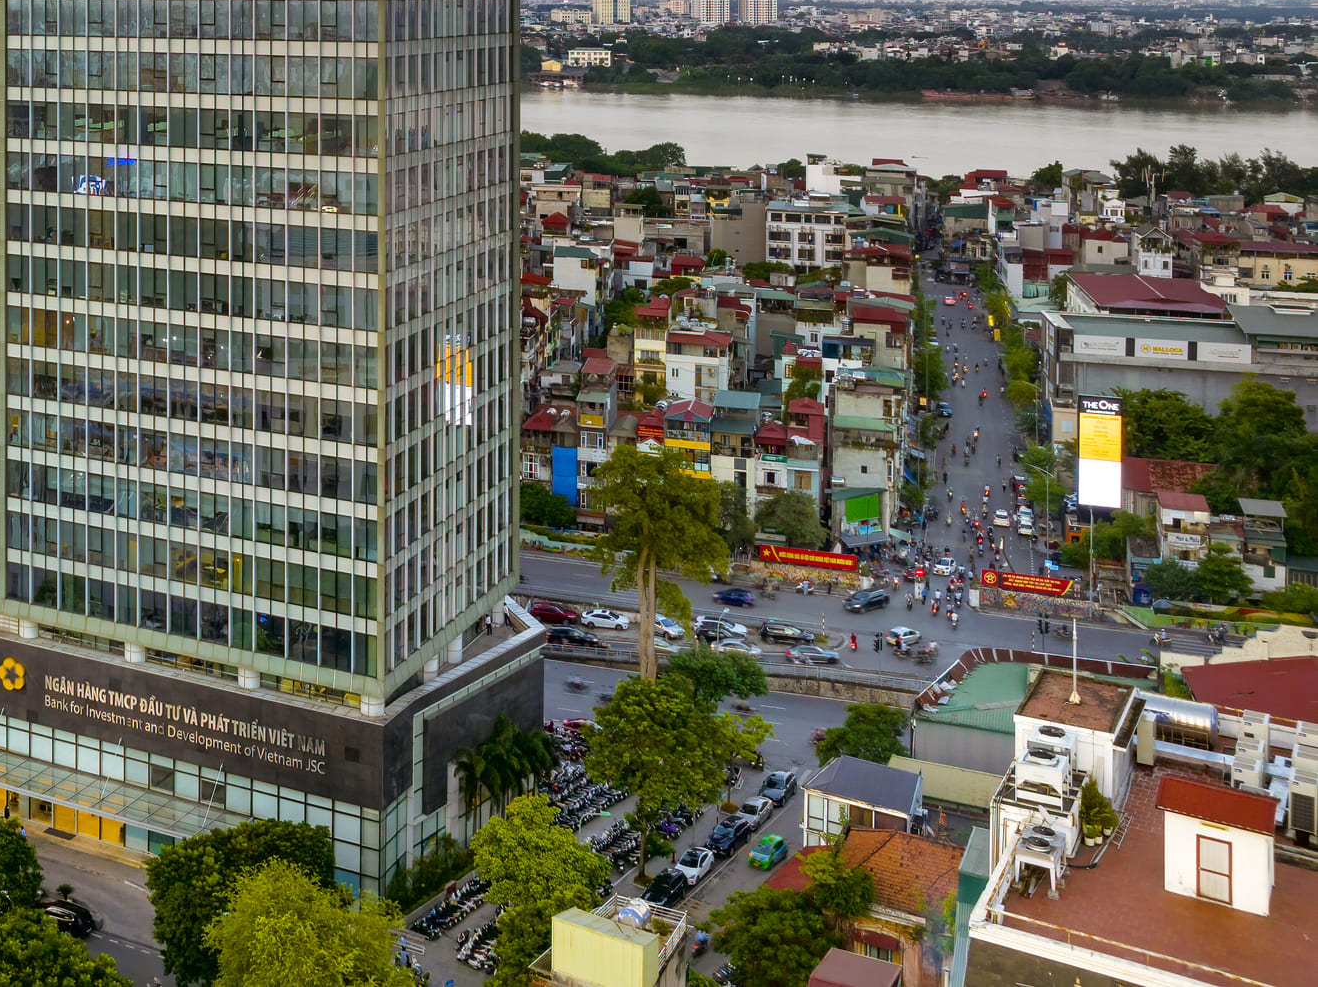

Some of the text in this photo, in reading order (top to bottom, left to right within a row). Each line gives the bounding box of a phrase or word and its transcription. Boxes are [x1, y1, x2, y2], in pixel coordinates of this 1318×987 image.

[44, 675, 74, 696] NGÂN
[77, 681, 106, 703] HÀNG
[108, 690, 138, 710] TMCP
[139, 695, 163, 717] ĐẦU
[165, 704, 181, 721] TƯ
[182, 706, 198, 726] VÀ
[200, 713, 230, 733] PHÁT
[231, 718, 266, 742] TRIỂN
[297, 734, 326, 757] NAM
[44, 694, 326, 775] Bank for Investment and Development of Vietnam JSC
